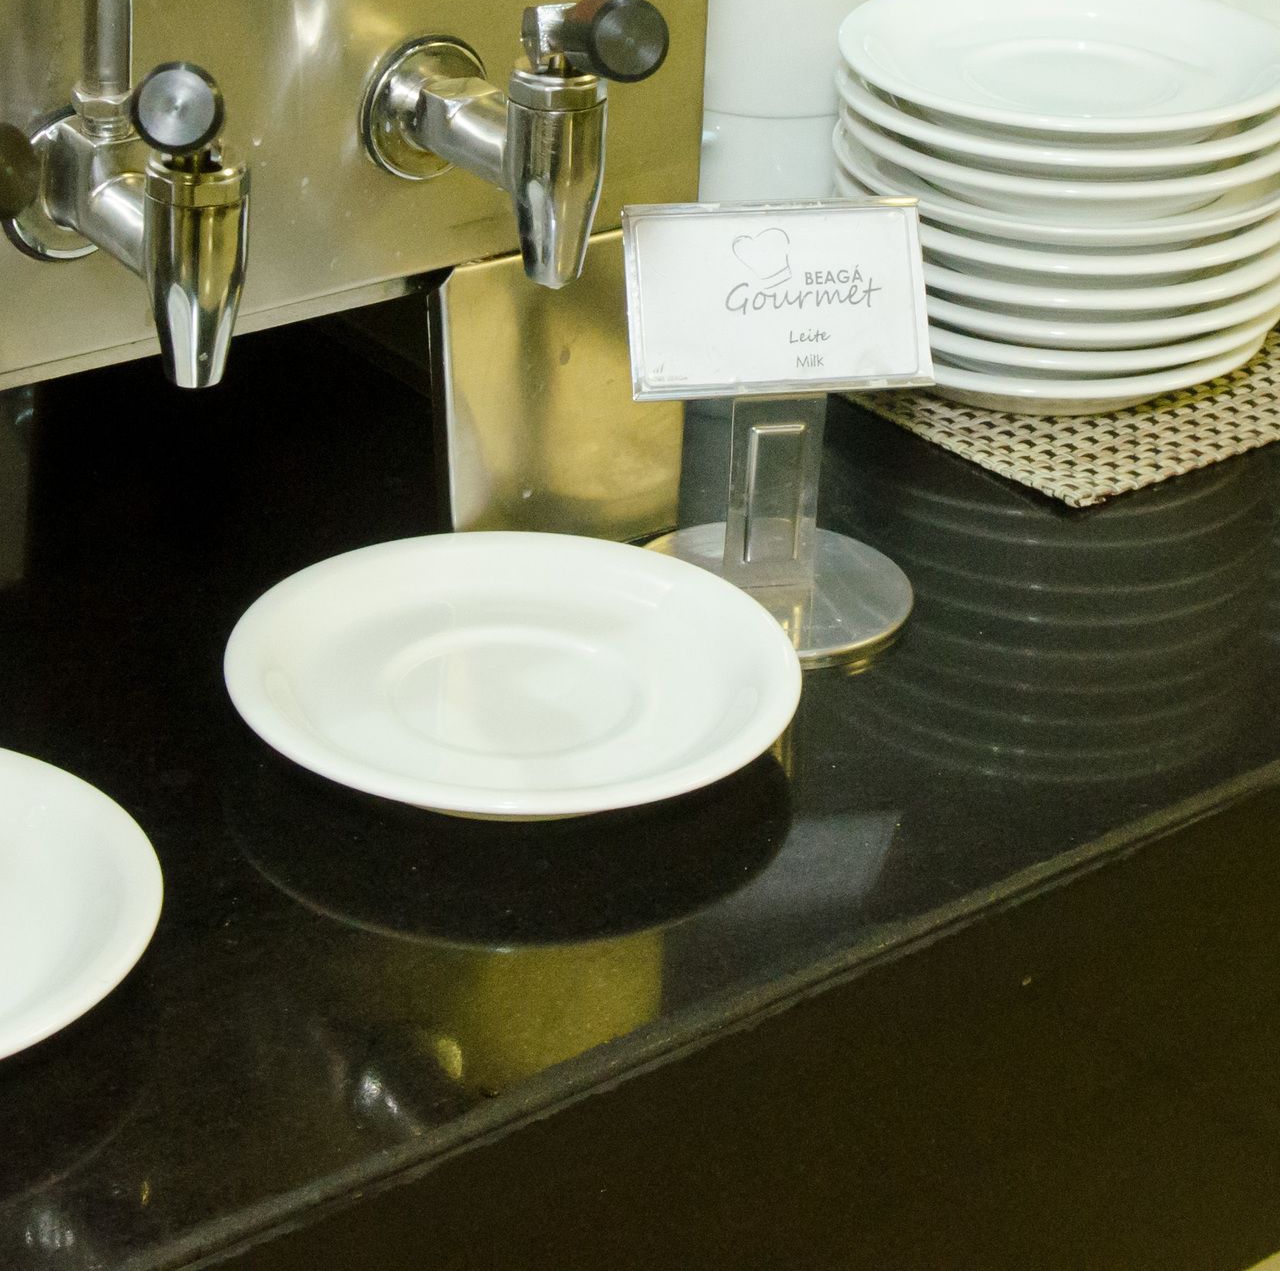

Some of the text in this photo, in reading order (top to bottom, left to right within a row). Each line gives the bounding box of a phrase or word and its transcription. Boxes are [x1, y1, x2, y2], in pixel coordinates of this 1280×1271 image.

[805, 265, 863, 285] BEAGÁ
[725, 277, 882, 315] Gourmet
[789, 330, 831, 344] Leite
[796, 354, 824, 368] Milk
